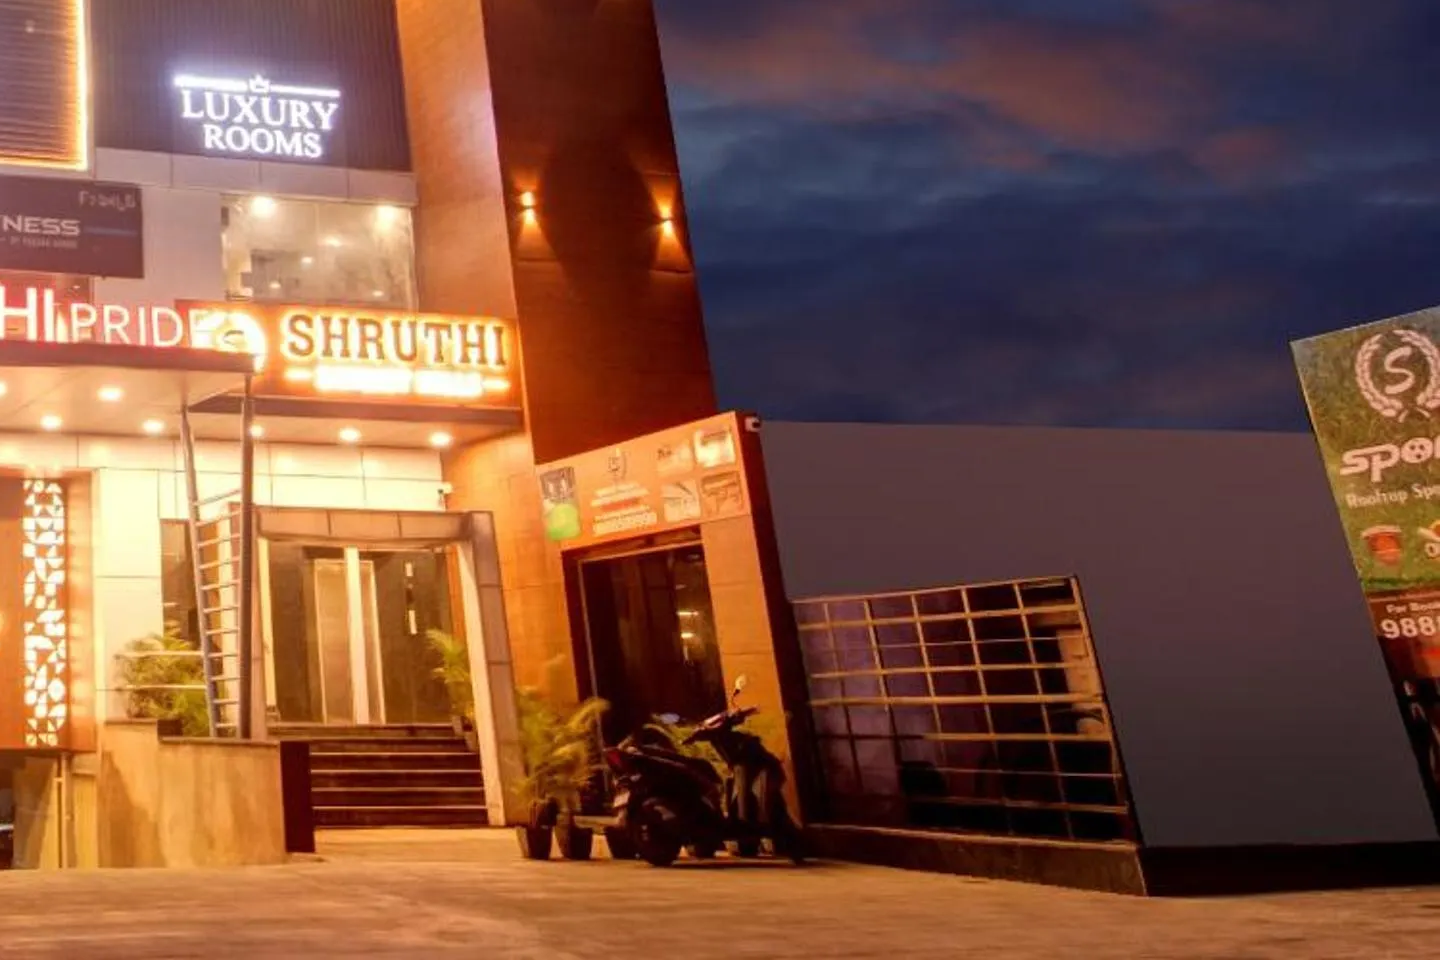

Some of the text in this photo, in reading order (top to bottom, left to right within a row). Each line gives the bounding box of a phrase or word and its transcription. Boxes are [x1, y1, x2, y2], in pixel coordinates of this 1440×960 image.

[181, 89, 339, 131] LUXURY
[204, 124, 322, 158] ROOMS
[287, 313, 505, 366] SHRUTHI
